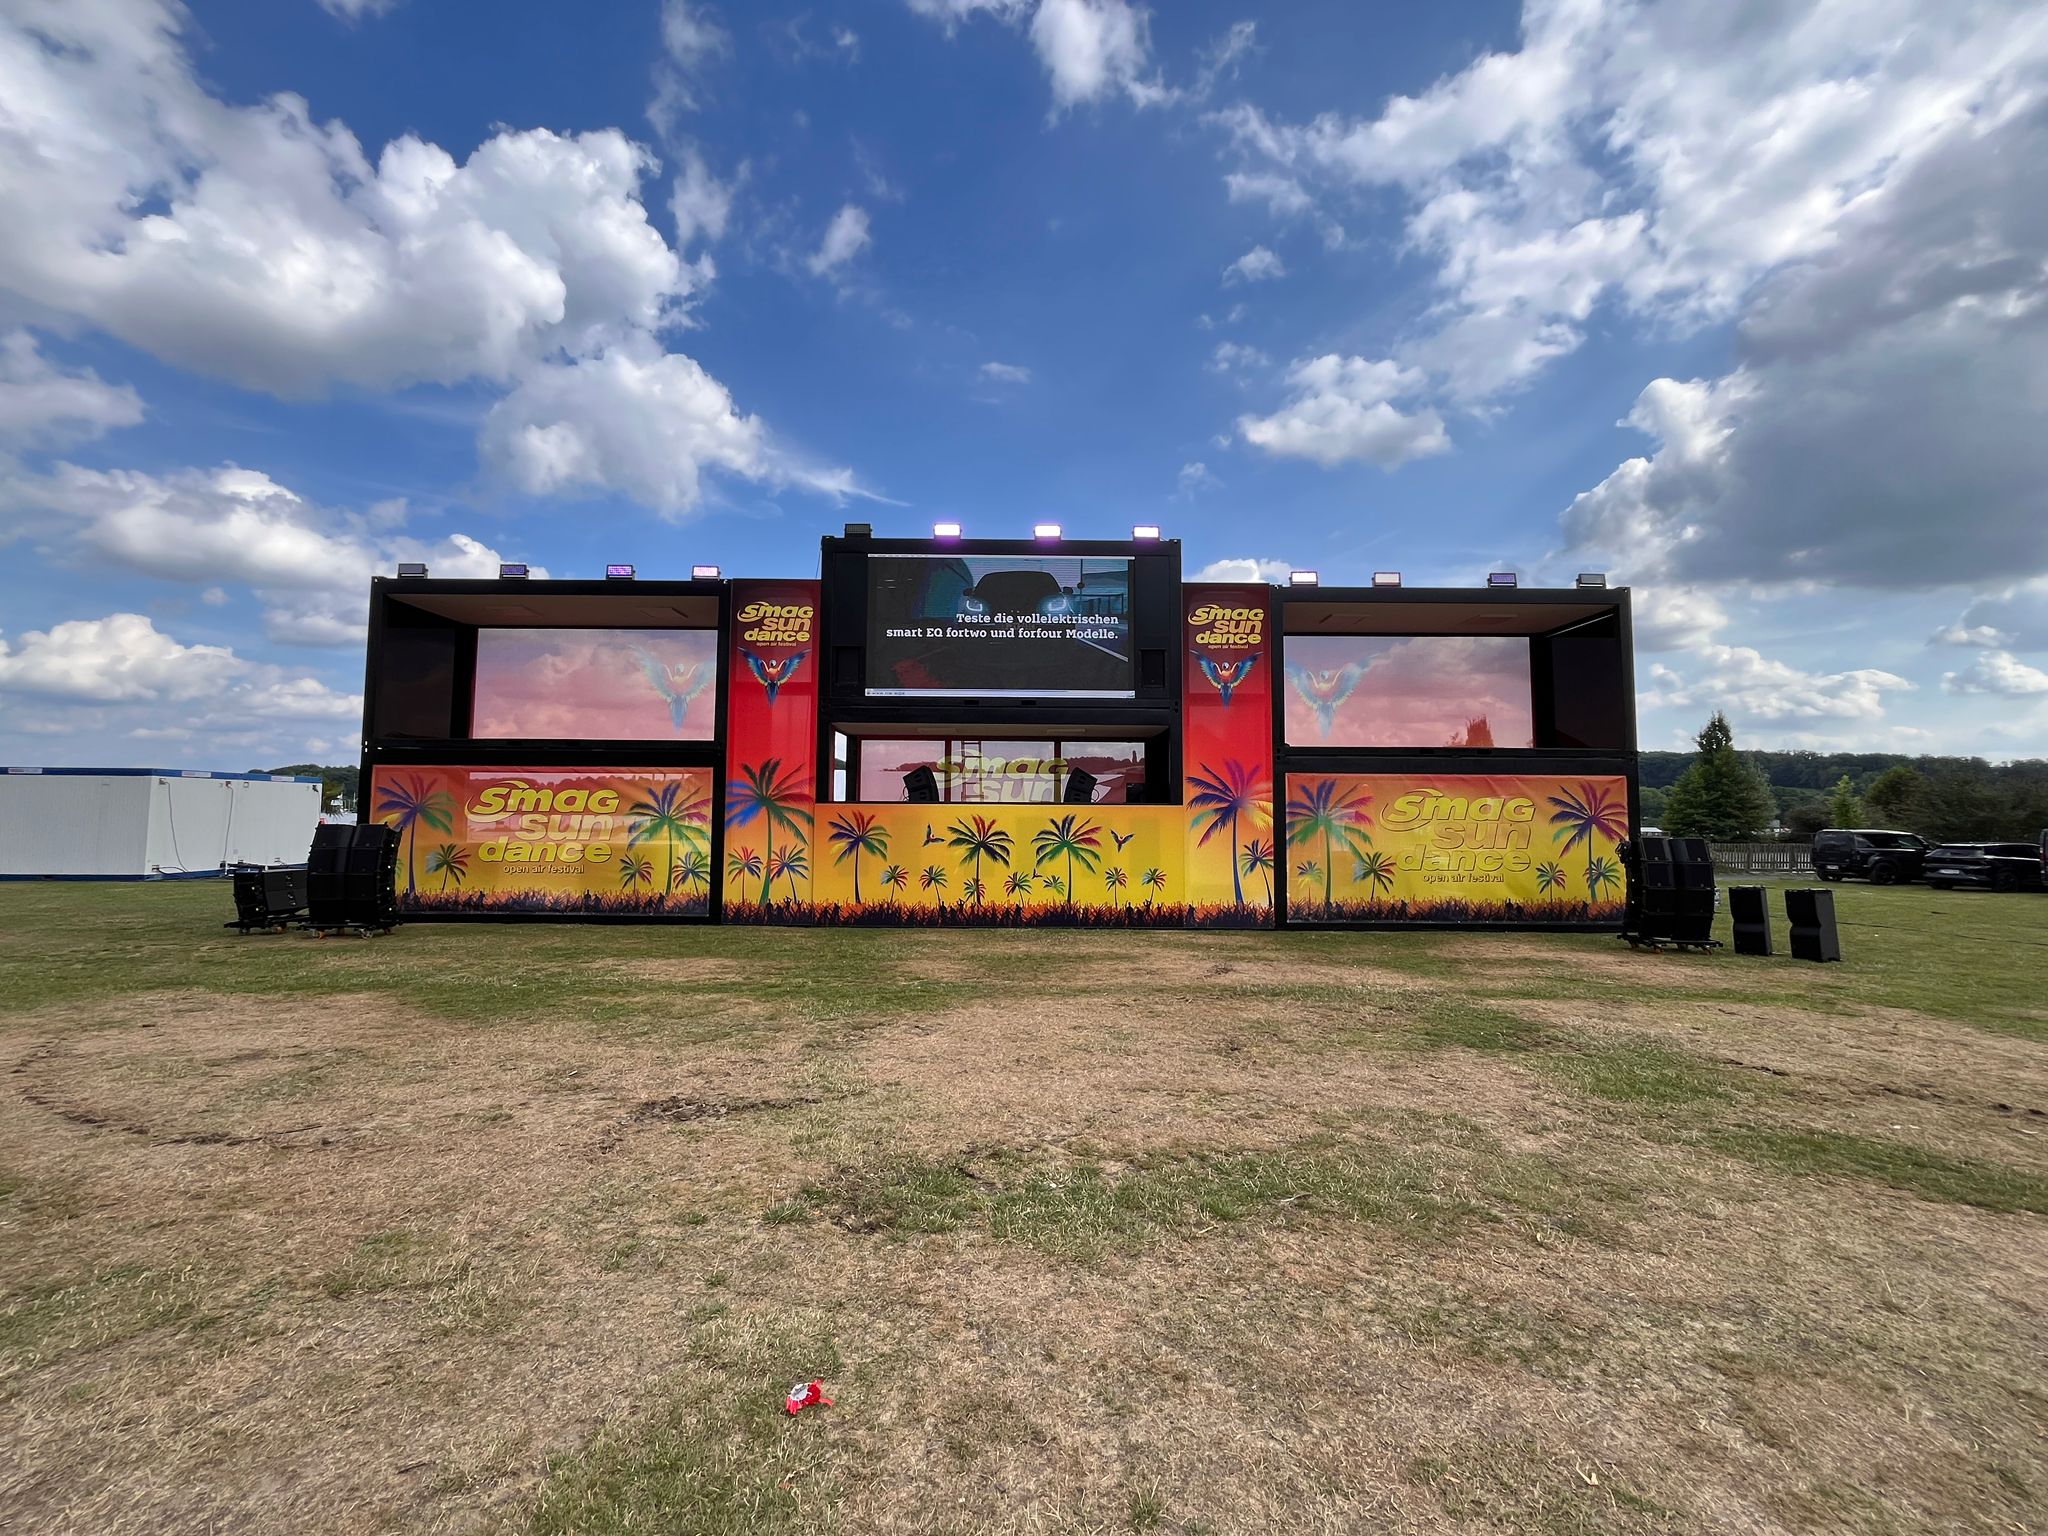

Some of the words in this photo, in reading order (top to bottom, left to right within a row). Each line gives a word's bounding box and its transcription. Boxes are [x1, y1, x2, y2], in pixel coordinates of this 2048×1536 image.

[762, 618, 811, 631] sun
[956, 613, 991, 624] Teste
[994, 613, 1014, 624] die
[1016, 613, 1119, 625] vollelektrischen
[886, 628, 923, 638] smart
[926, 627, 943, 638] EQ
[946, 627, 987, 638] fortwo
[990, 628, 1015, 638] und
[1018, 628, 1063, 639] forfour
[1065, 628, 1119, 640] Modelle.
[1213, 620, 1262, 634] sun
[743, 628, 811, 642] dance
[1195, 631, 1262, 644] dance
[515, 814, 614, 841] sun
[1430, 822, 1532, 850] sun
[478, 837, 613, 863] dance
[1396, 844, 1532, 872] dance
[503, 865, 529, 875] open
[531, 865, 547, 873] air
[548, 864, 585, 874] festival
[1423, 875, 1449, 884] open
[1451, 874, 1465, 883] air
